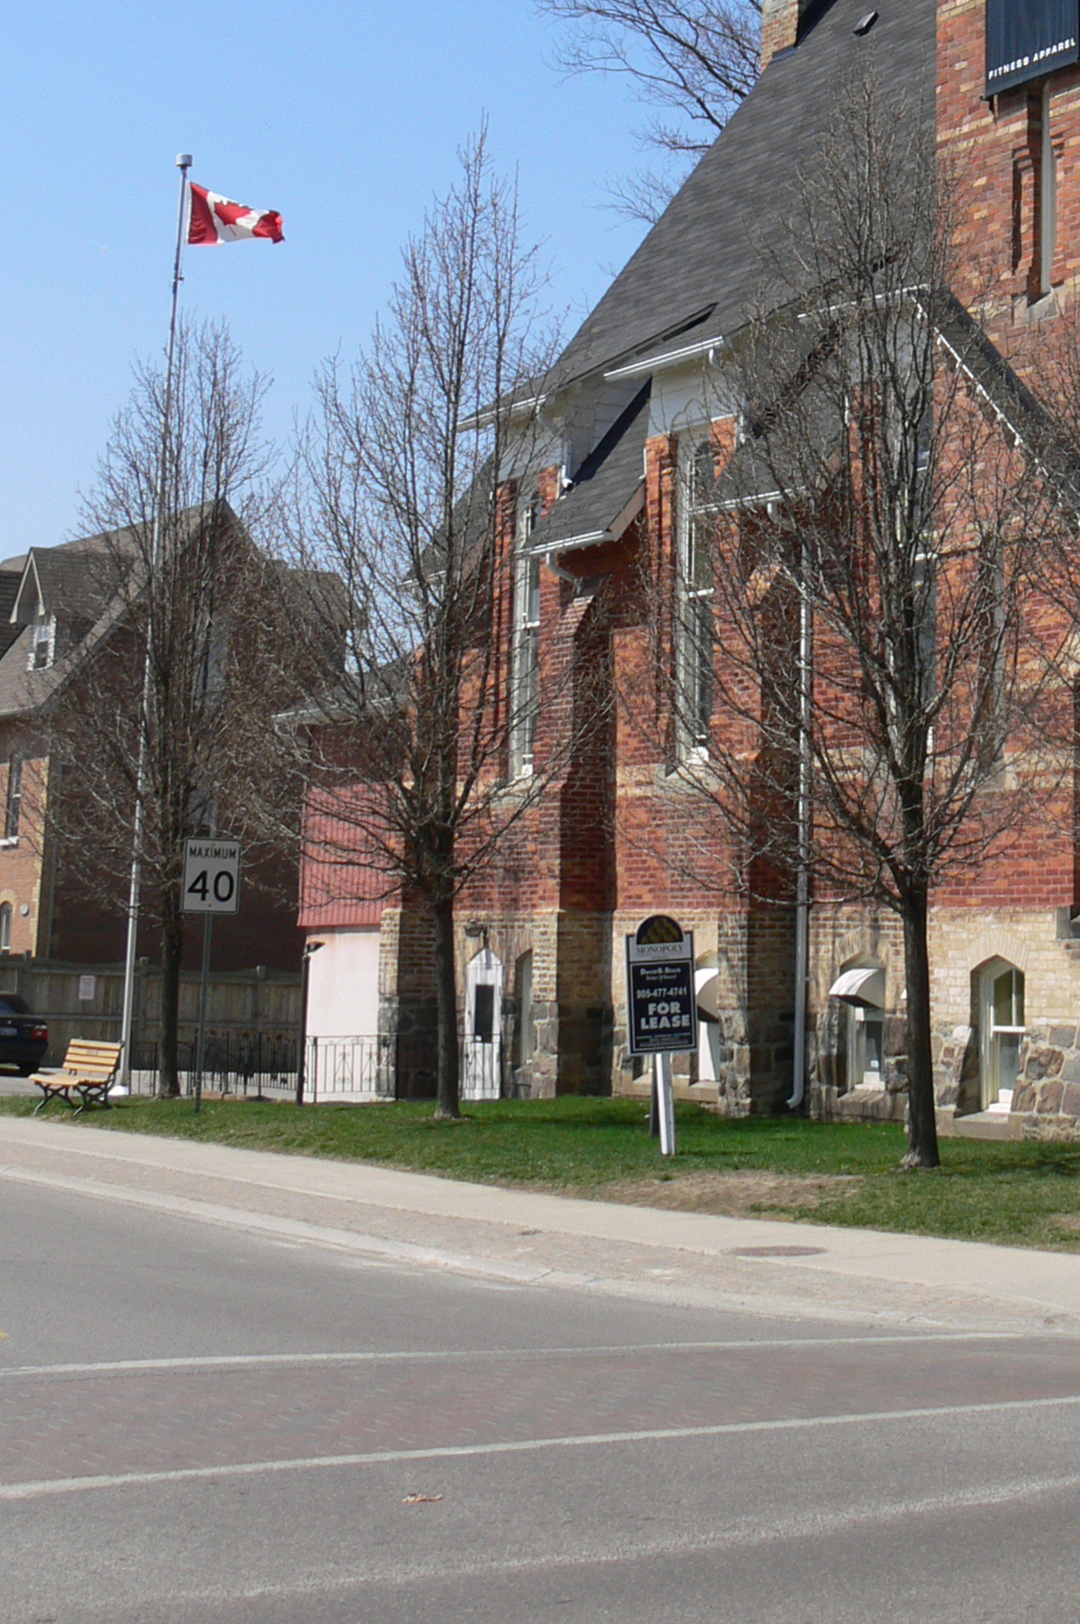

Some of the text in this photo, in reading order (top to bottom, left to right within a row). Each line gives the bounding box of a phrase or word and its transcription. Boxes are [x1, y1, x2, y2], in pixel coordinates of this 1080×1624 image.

[988, 37, 1076, 80] FITNESS APPAREL
[189, 845, 237, 860] MAXIMUM
[187, 870, 235, 903] 40
[637, 944, 683, 954] MONOPOLY
[636, 985, 688, 999] 905-477-4741
[648, 1001, 681, 1016] FOR
[640, 1014, 690, 1030] LEASE
